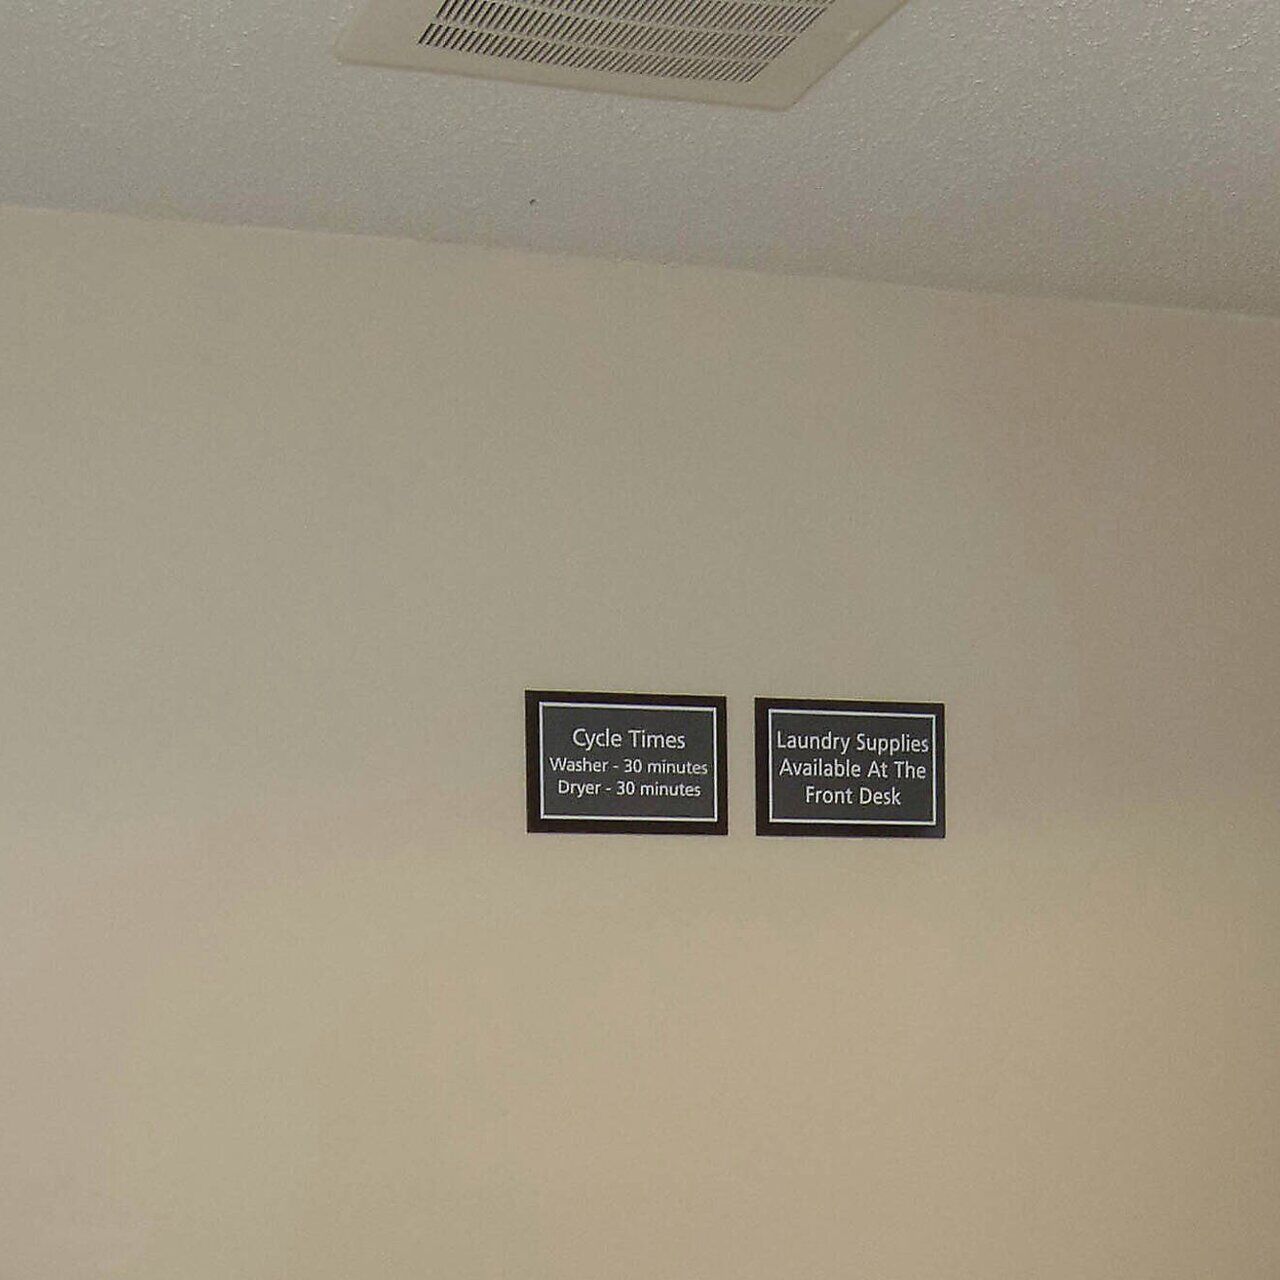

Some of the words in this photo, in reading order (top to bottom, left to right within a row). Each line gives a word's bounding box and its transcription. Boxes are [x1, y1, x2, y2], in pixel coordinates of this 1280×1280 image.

[572, 728, 622, 751] Cycle
[627, 729, 686, 749] Times
[777, 730, 851, 755] Laundry
[856, 733, 929, 756] Supplies
[549, 757, 609, 773] Washer
[623, 759, 643, 774] 30
[647, 759, 708, 776] minutes
[779, 758, 862, 778] Available
[867, 761, 889, 779] At
[894, 761, 927, 780] The
[558, 780, 602, 799] Dryer
[616, 781, 636, 796] 30
[640, 781, 702, 798] minutes
[806, 786, 853, 804] Front
[859, 787, 901, 806] Desk
